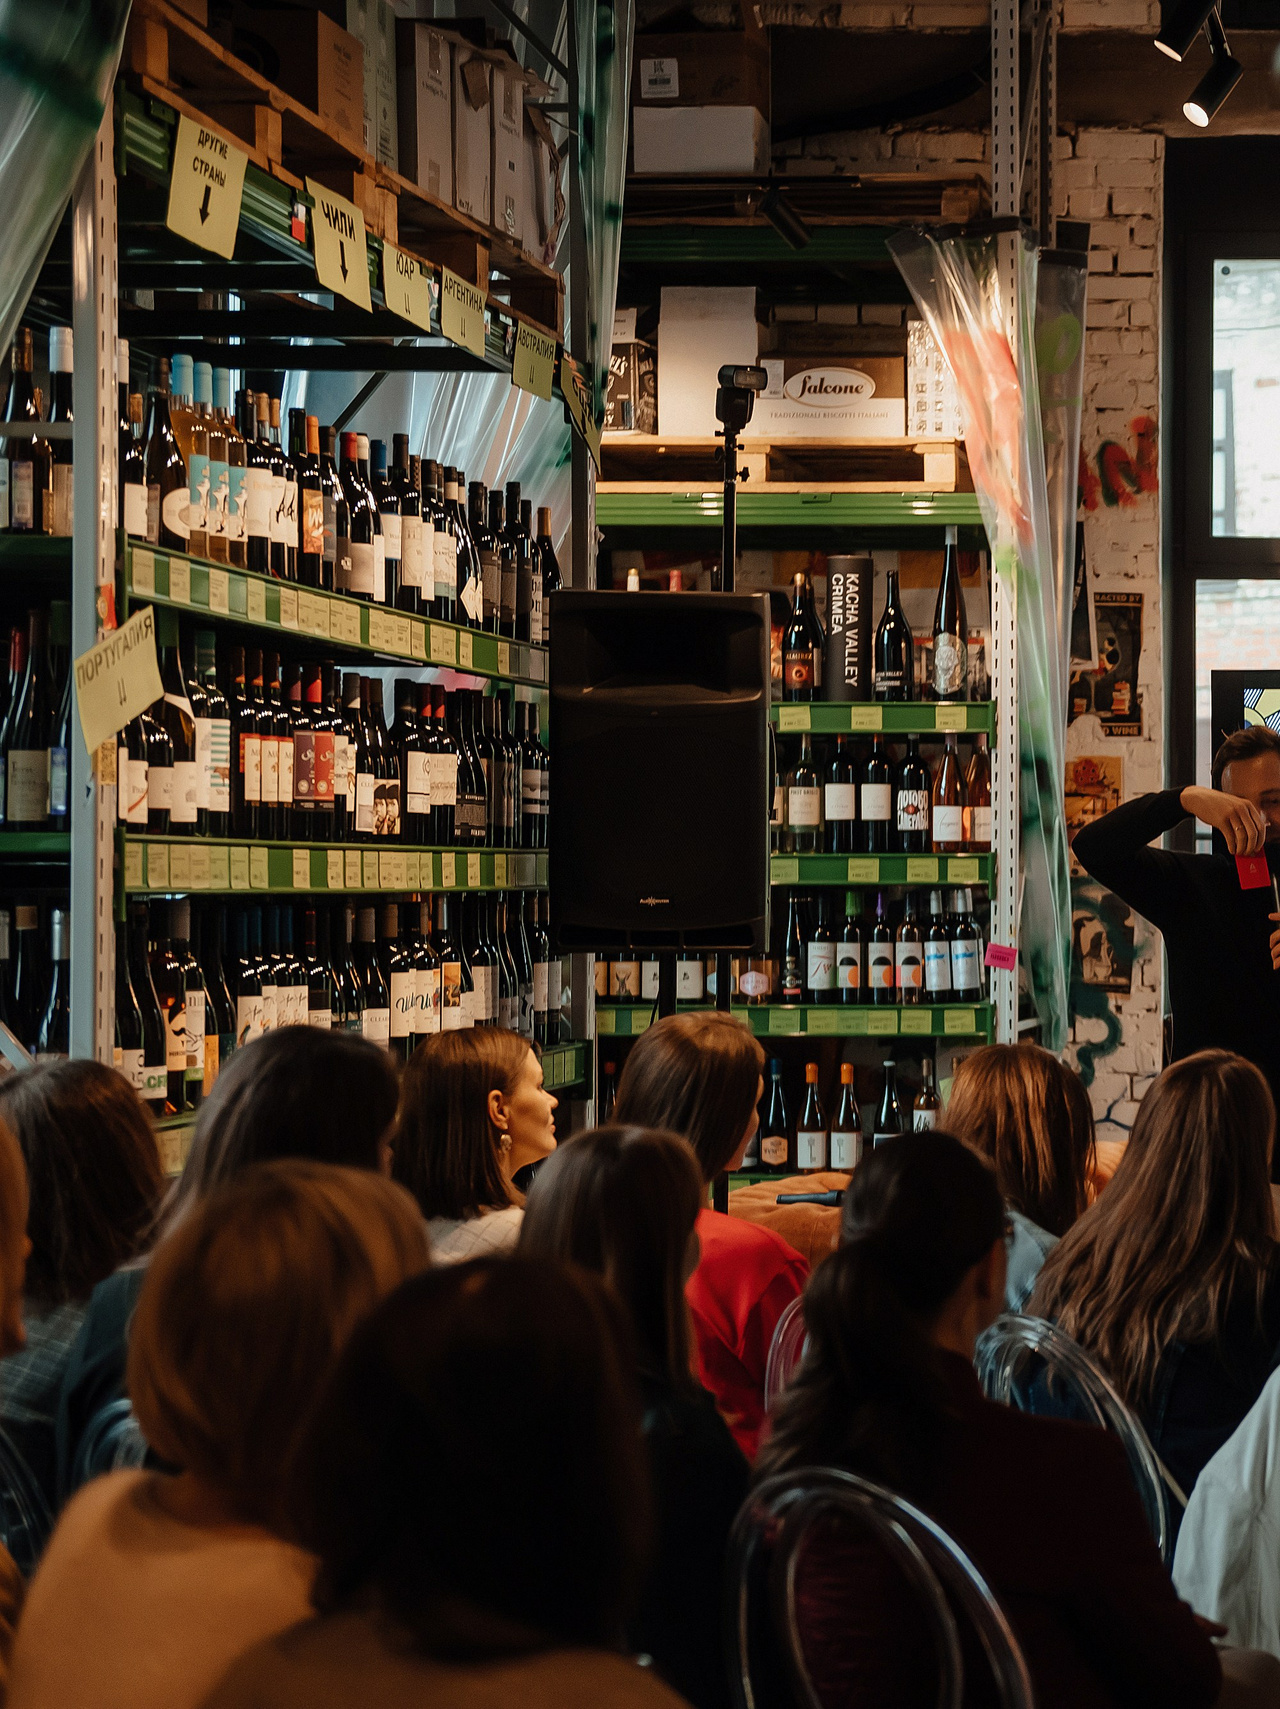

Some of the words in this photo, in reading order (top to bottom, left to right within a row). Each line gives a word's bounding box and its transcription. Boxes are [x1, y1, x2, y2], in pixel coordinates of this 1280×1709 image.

[198, 129, 228, 159] ДРУГИЕ
[192, 157, 227, 188] СТРАНЫ
[321, 200, 356, 242] ЧИЛИ
[395, 252, 415, 280] ЮАР
[443, 277, 483, 314] АРГЕНТИНА
[517, 329, 556, 361] АВСТРАЛИЯ
[798, 375, 865, 399] falcone
[831, 573, 844, 635] CRIMEA
[845, 573, 859, 624] KACHA
[77, 615, 154, 690] ПОРТУГАЛИЯ
[845, 628, 859, 687] VALLEY
[1111, 726, 1139, 736] WINE
